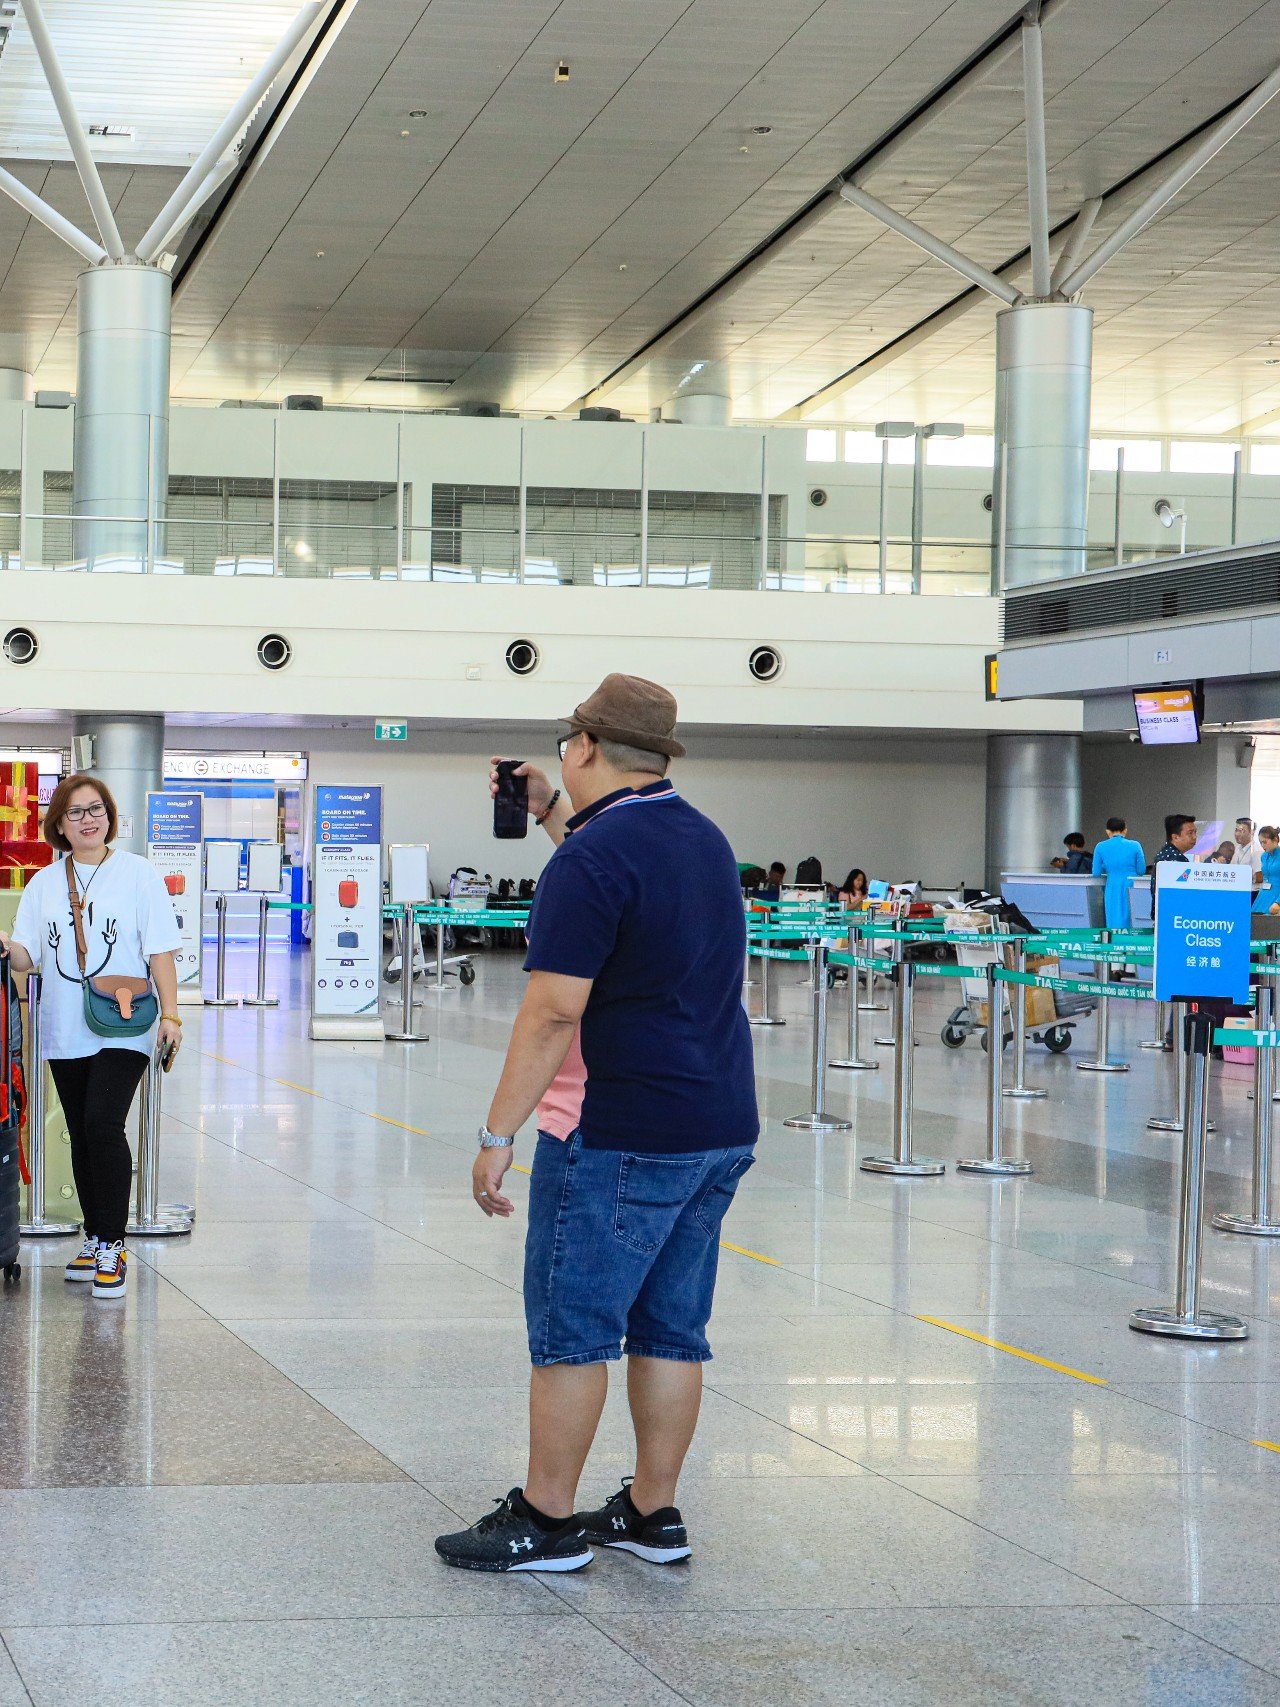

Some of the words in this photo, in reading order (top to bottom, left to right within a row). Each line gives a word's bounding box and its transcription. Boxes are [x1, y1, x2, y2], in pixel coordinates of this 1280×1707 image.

[212, 762, 270, 775] EXCHANGE
[1173, 916, 1234, 934] Economy
[1059, 943, 1082, 951] TIA
[1186, 934, 1221, 947] Class
[1186, 956, 1221, 968] 经济舱
[1035, 977, 1052, 989] TIA
[1146, 989, 1154, 998] SƠ
